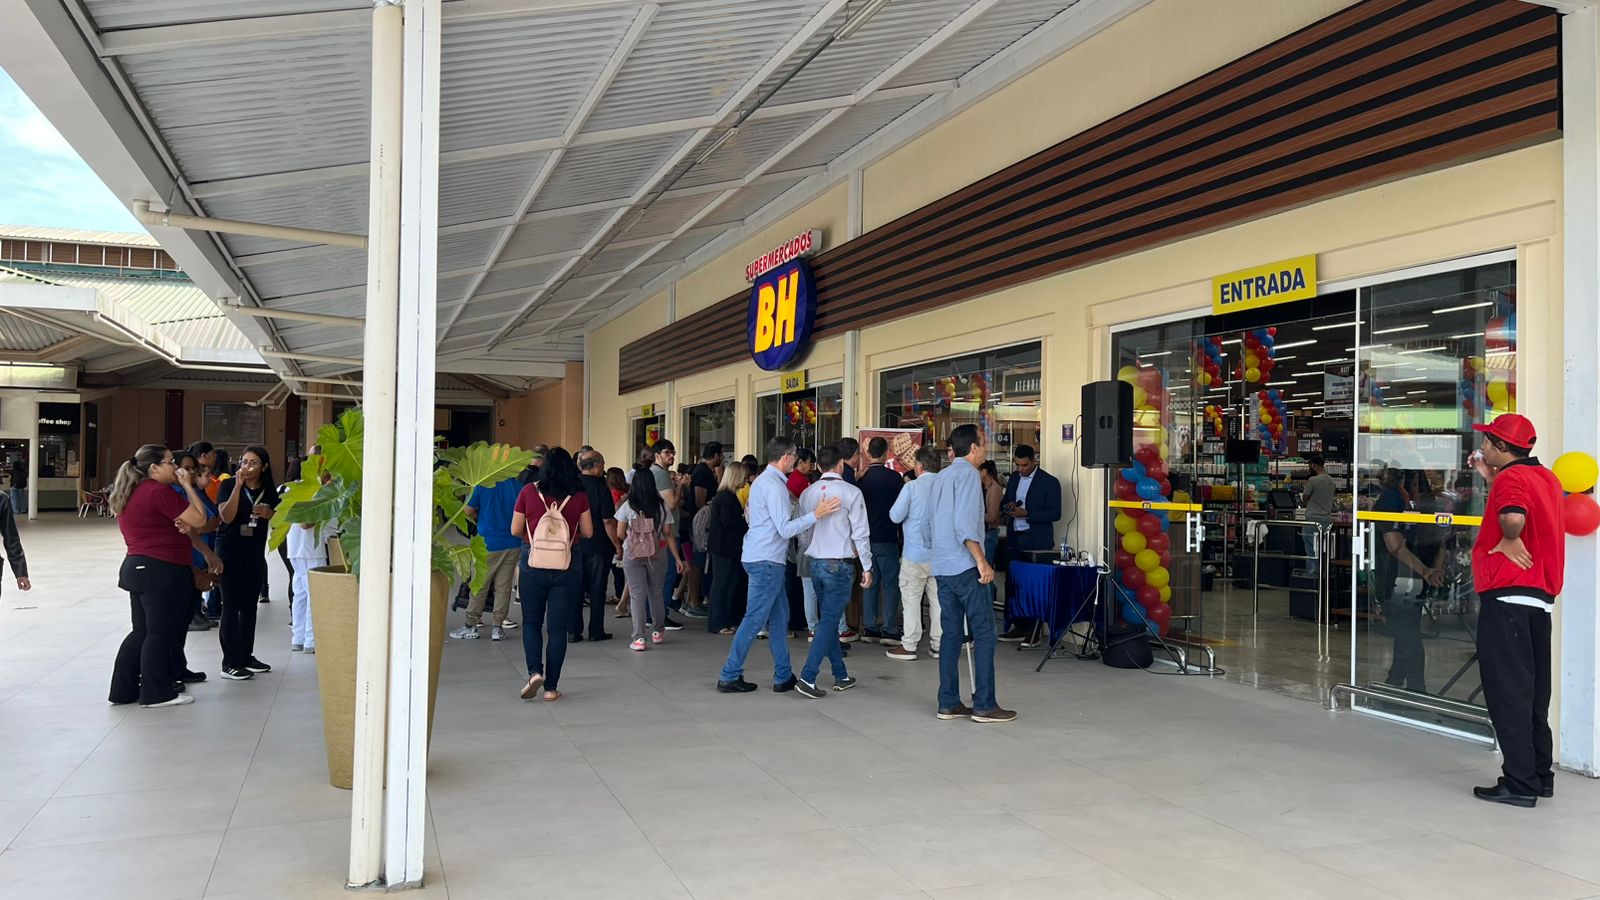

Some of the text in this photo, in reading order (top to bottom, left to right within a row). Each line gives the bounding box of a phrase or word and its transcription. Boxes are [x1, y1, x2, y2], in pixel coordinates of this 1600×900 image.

[745, 229, 812, 281] SUPERMERCADOS
[1220, 268, 1305, 304] ENTRADA
[754, 268, 799, 353] BH
[785, 375, 799, 389] SAÍDA
[997, 434, 1009, 442] 04
